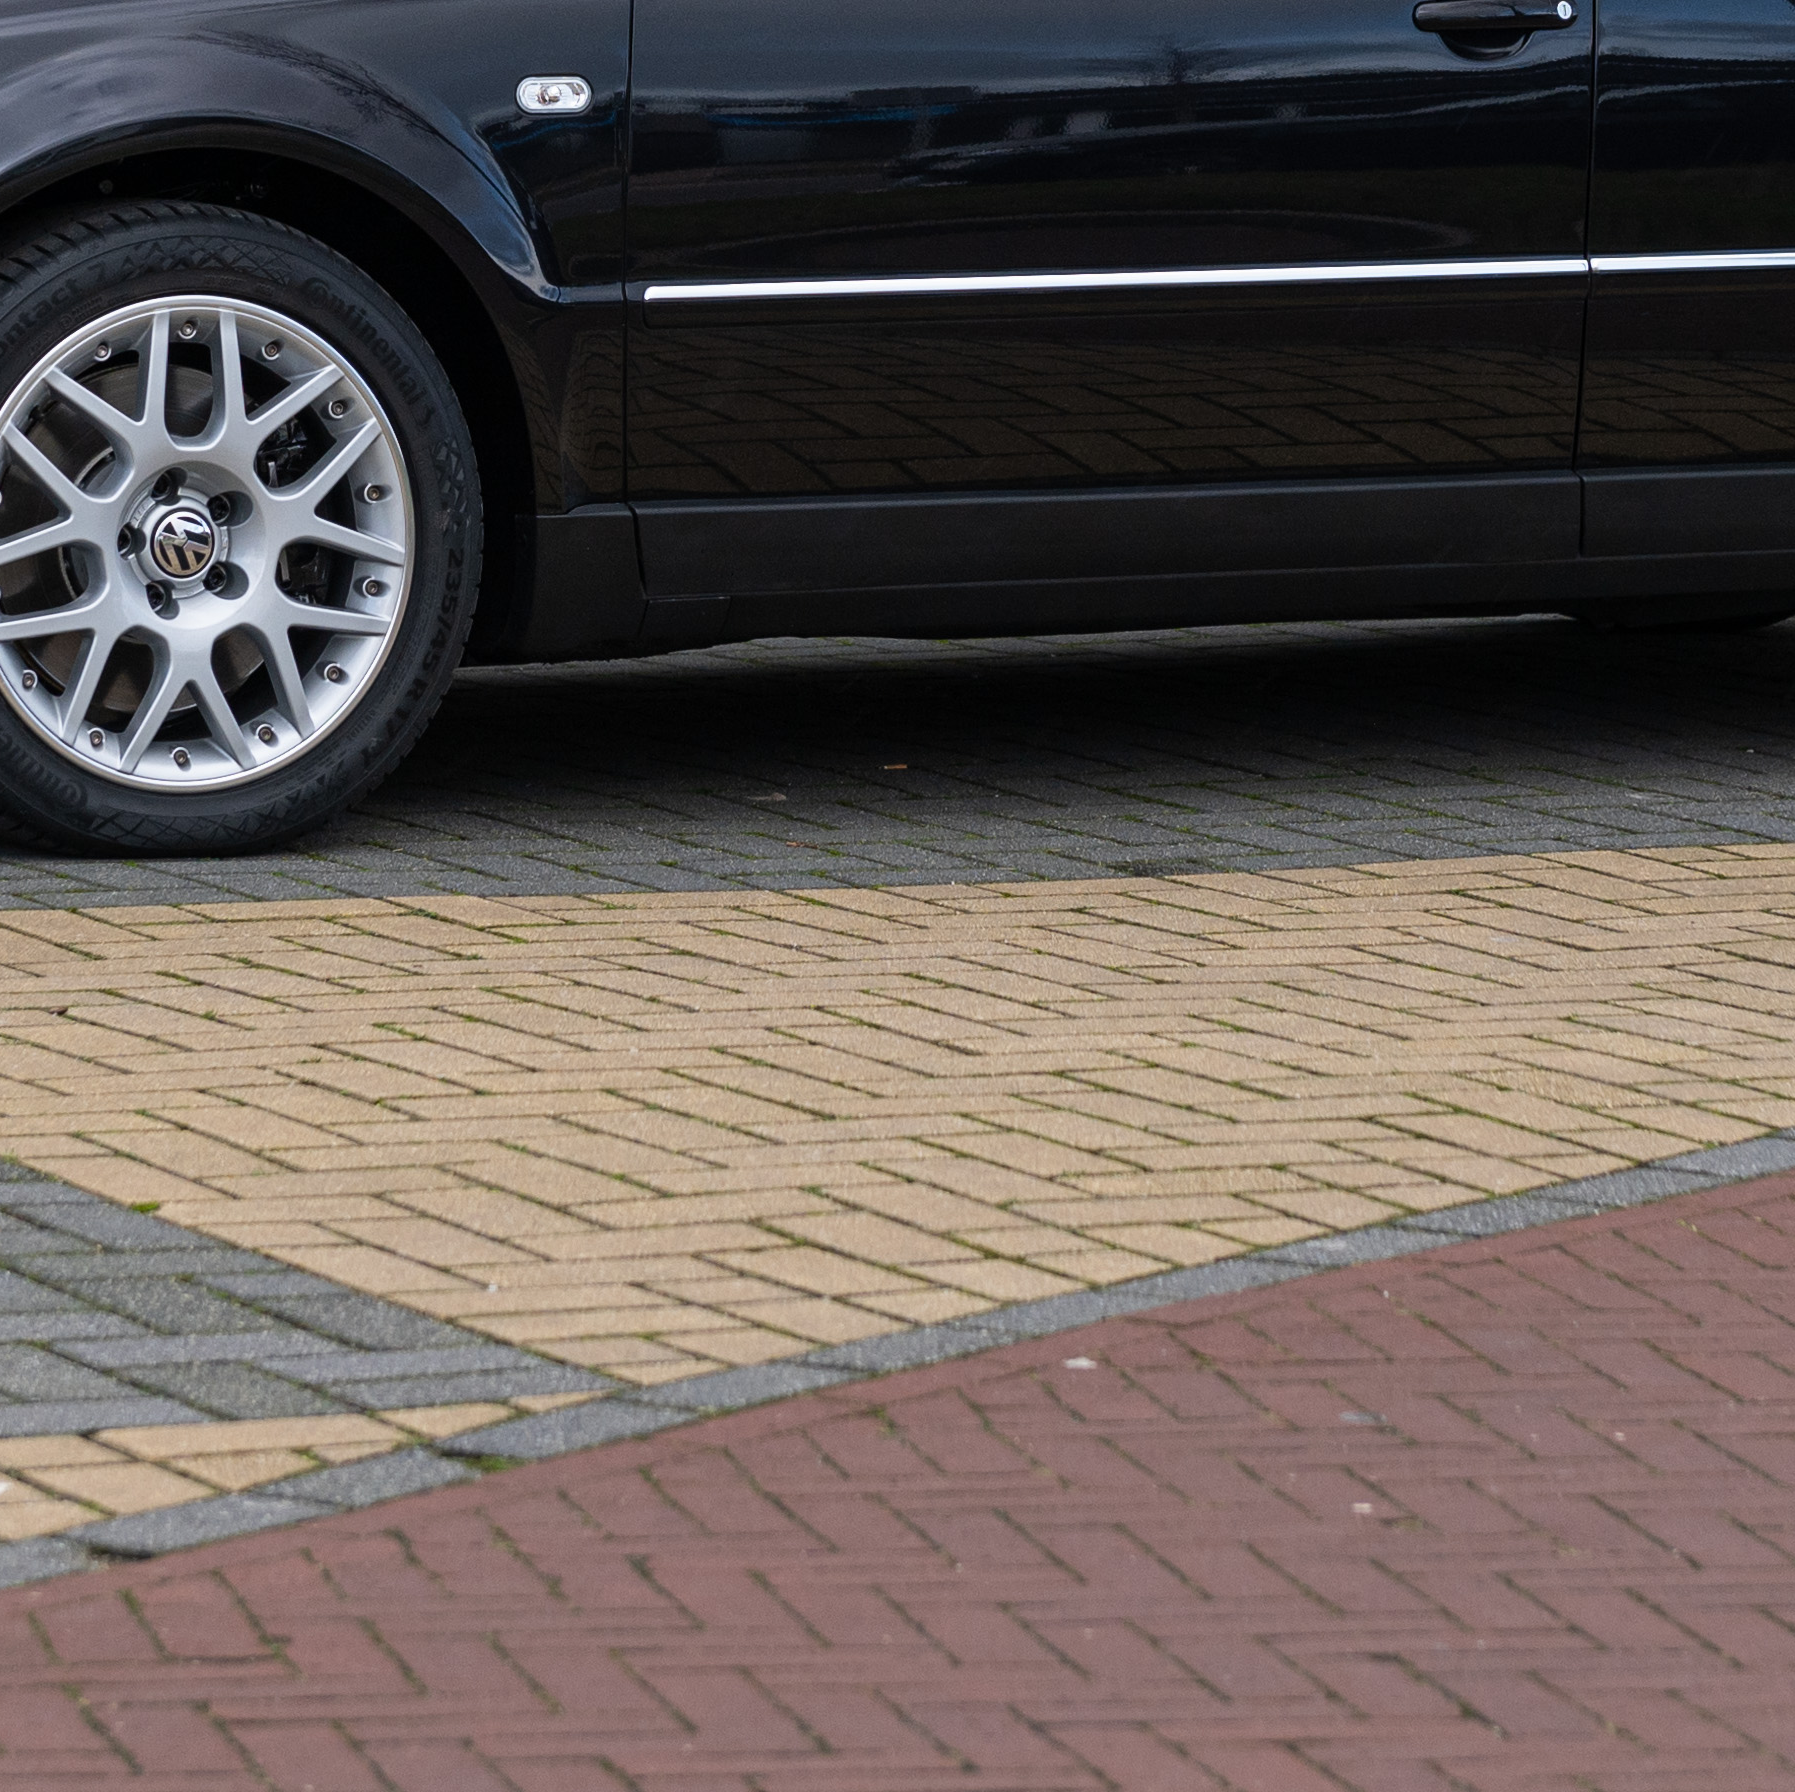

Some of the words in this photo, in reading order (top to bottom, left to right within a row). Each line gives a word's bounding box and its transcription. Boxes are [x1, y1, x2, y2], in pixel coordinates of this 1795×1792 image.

[295, 272, 430, 408] Continental
[418, 546, 463, 677] 235/45
[403, 674, 430, 706] R
